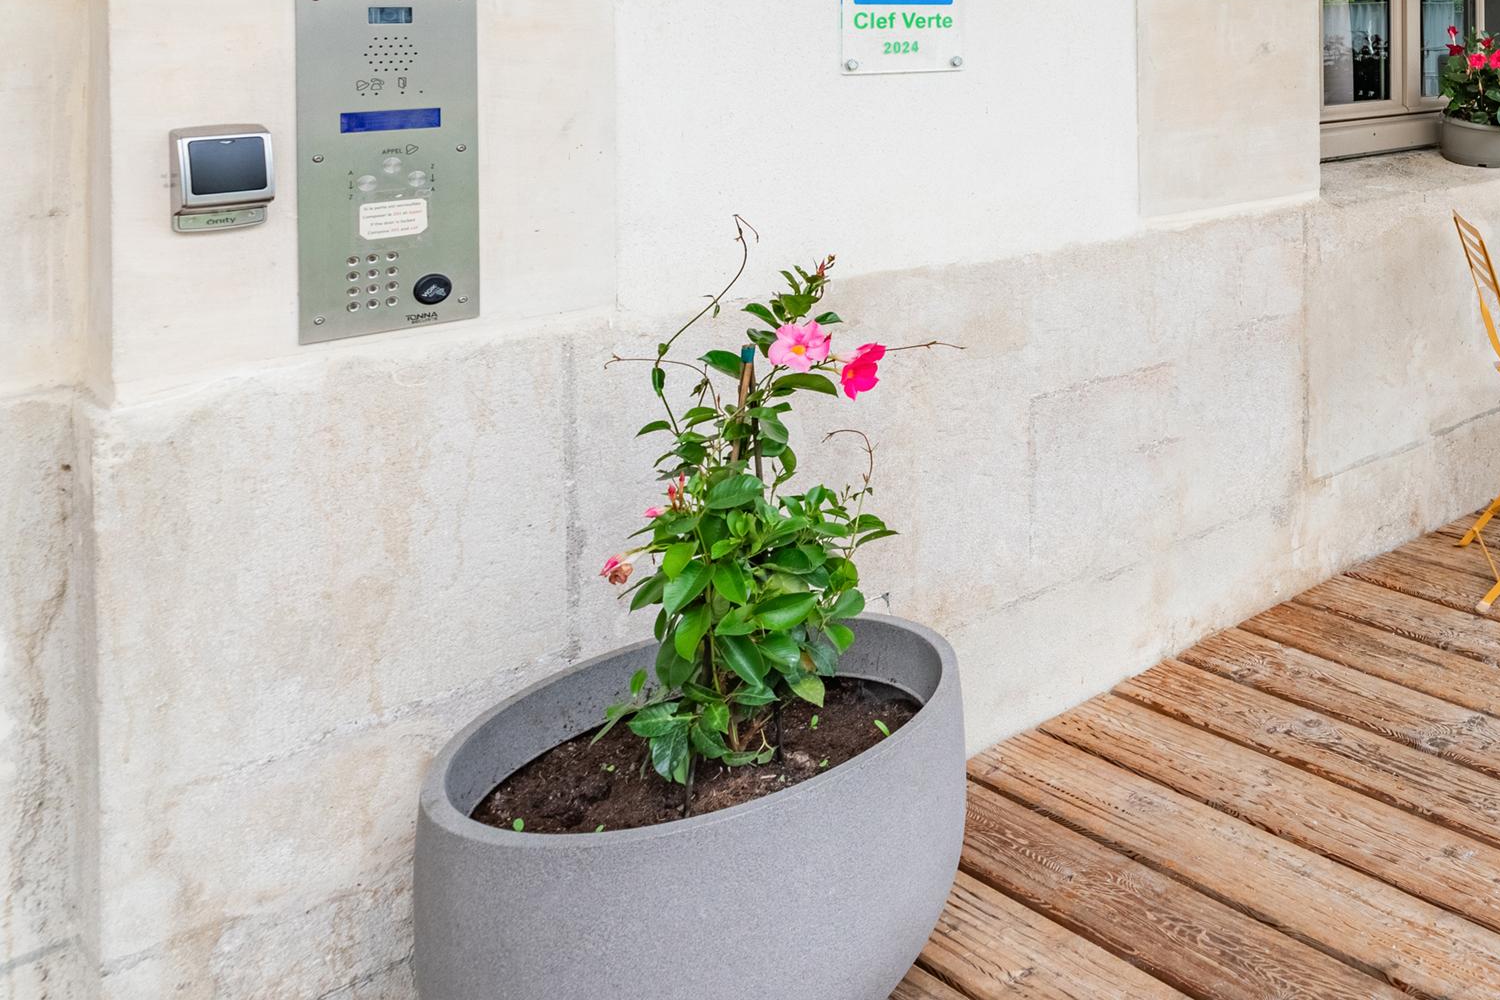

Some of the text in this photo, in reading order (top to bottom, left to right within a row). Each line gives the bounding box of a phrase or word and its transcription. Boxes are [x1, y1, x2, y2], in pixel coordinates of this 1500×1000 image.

[854, 12, 953, 30] Clef Verte
[883, 41, 919, 54] 2024
